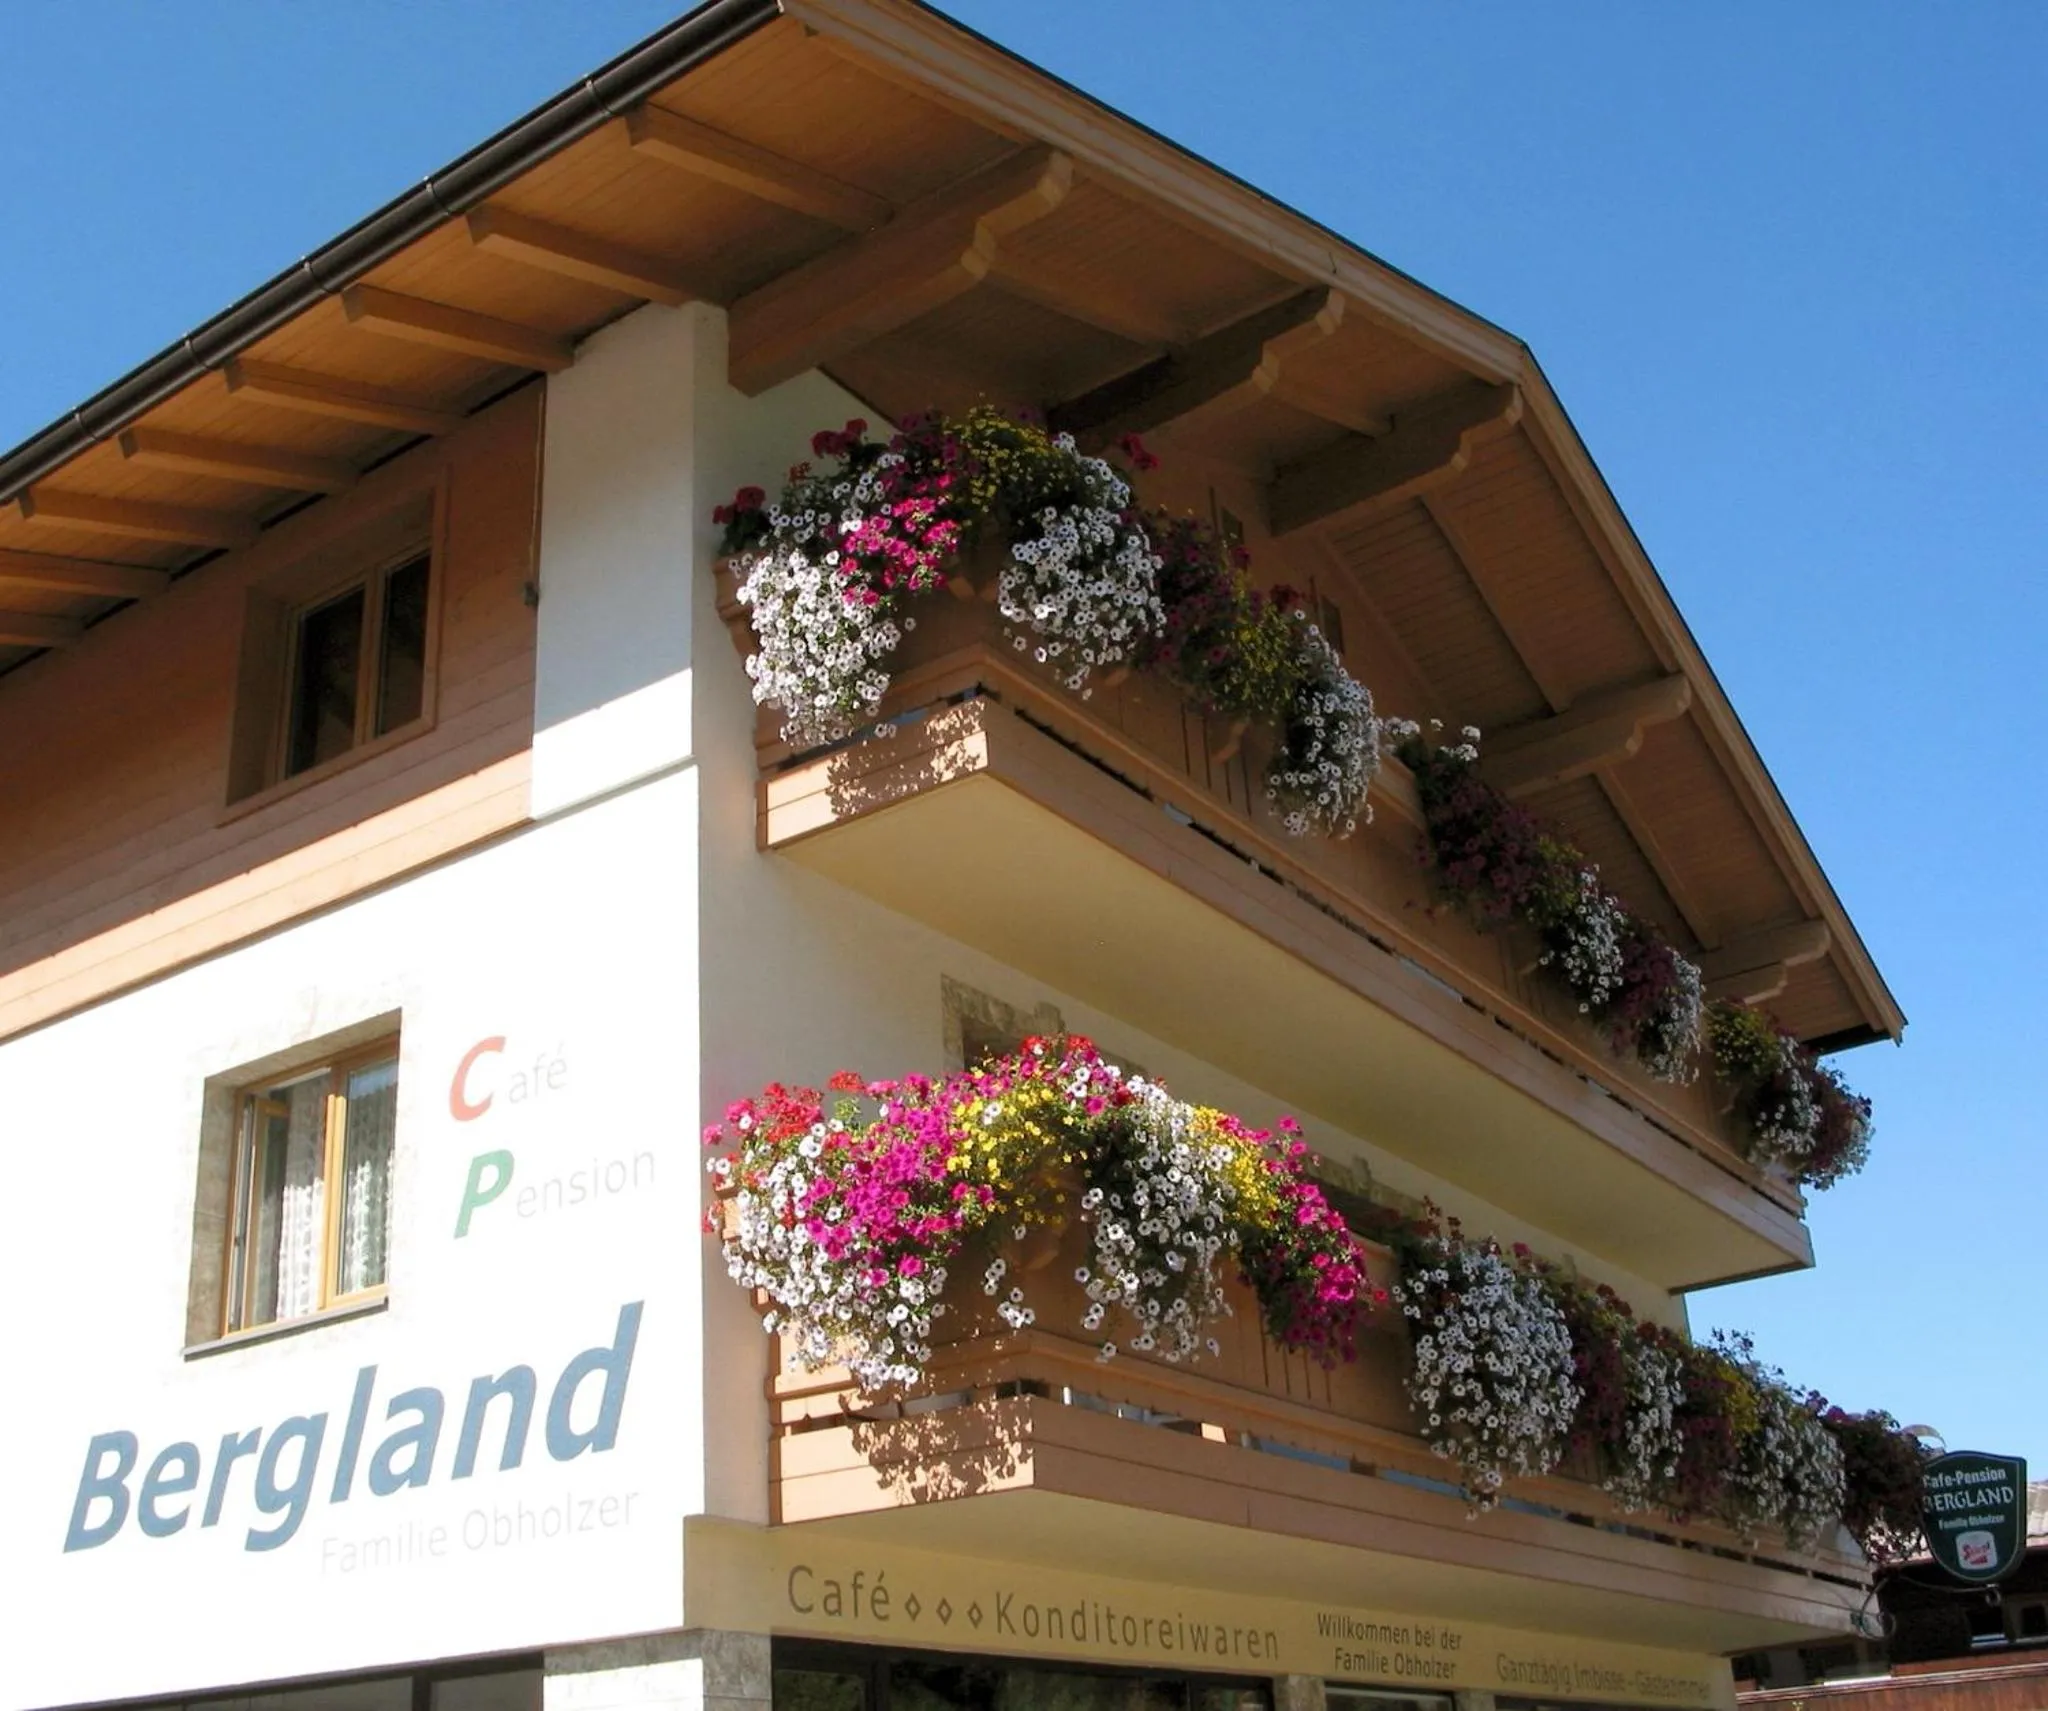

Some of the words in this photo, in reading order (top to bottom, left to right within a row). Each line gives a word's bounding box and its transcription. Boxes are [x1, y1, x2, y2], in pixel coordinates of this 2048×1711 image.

[449, 1036, 568, 1121] Café
[453, 1149, 655, 1240] Pension
[63, 1300, 645, 1554] Bergland
[321, 1518, 448, 1576] Familie
[463, 1491, 640, 1551] Obholzer
[787, 1564, 891, 1622] Café
[996, 1592, 1280, 1661] Konditoreiwaren
[1317, 1612, 1410, 1645] Willkommen
[1414, 1623, 1436, 1647] bei
[1441, 1628, 1463, 1650] der
[1334, 1646, 1389, 1674] Familie
[1394, 1651, 1457, 1679] Obholzer
